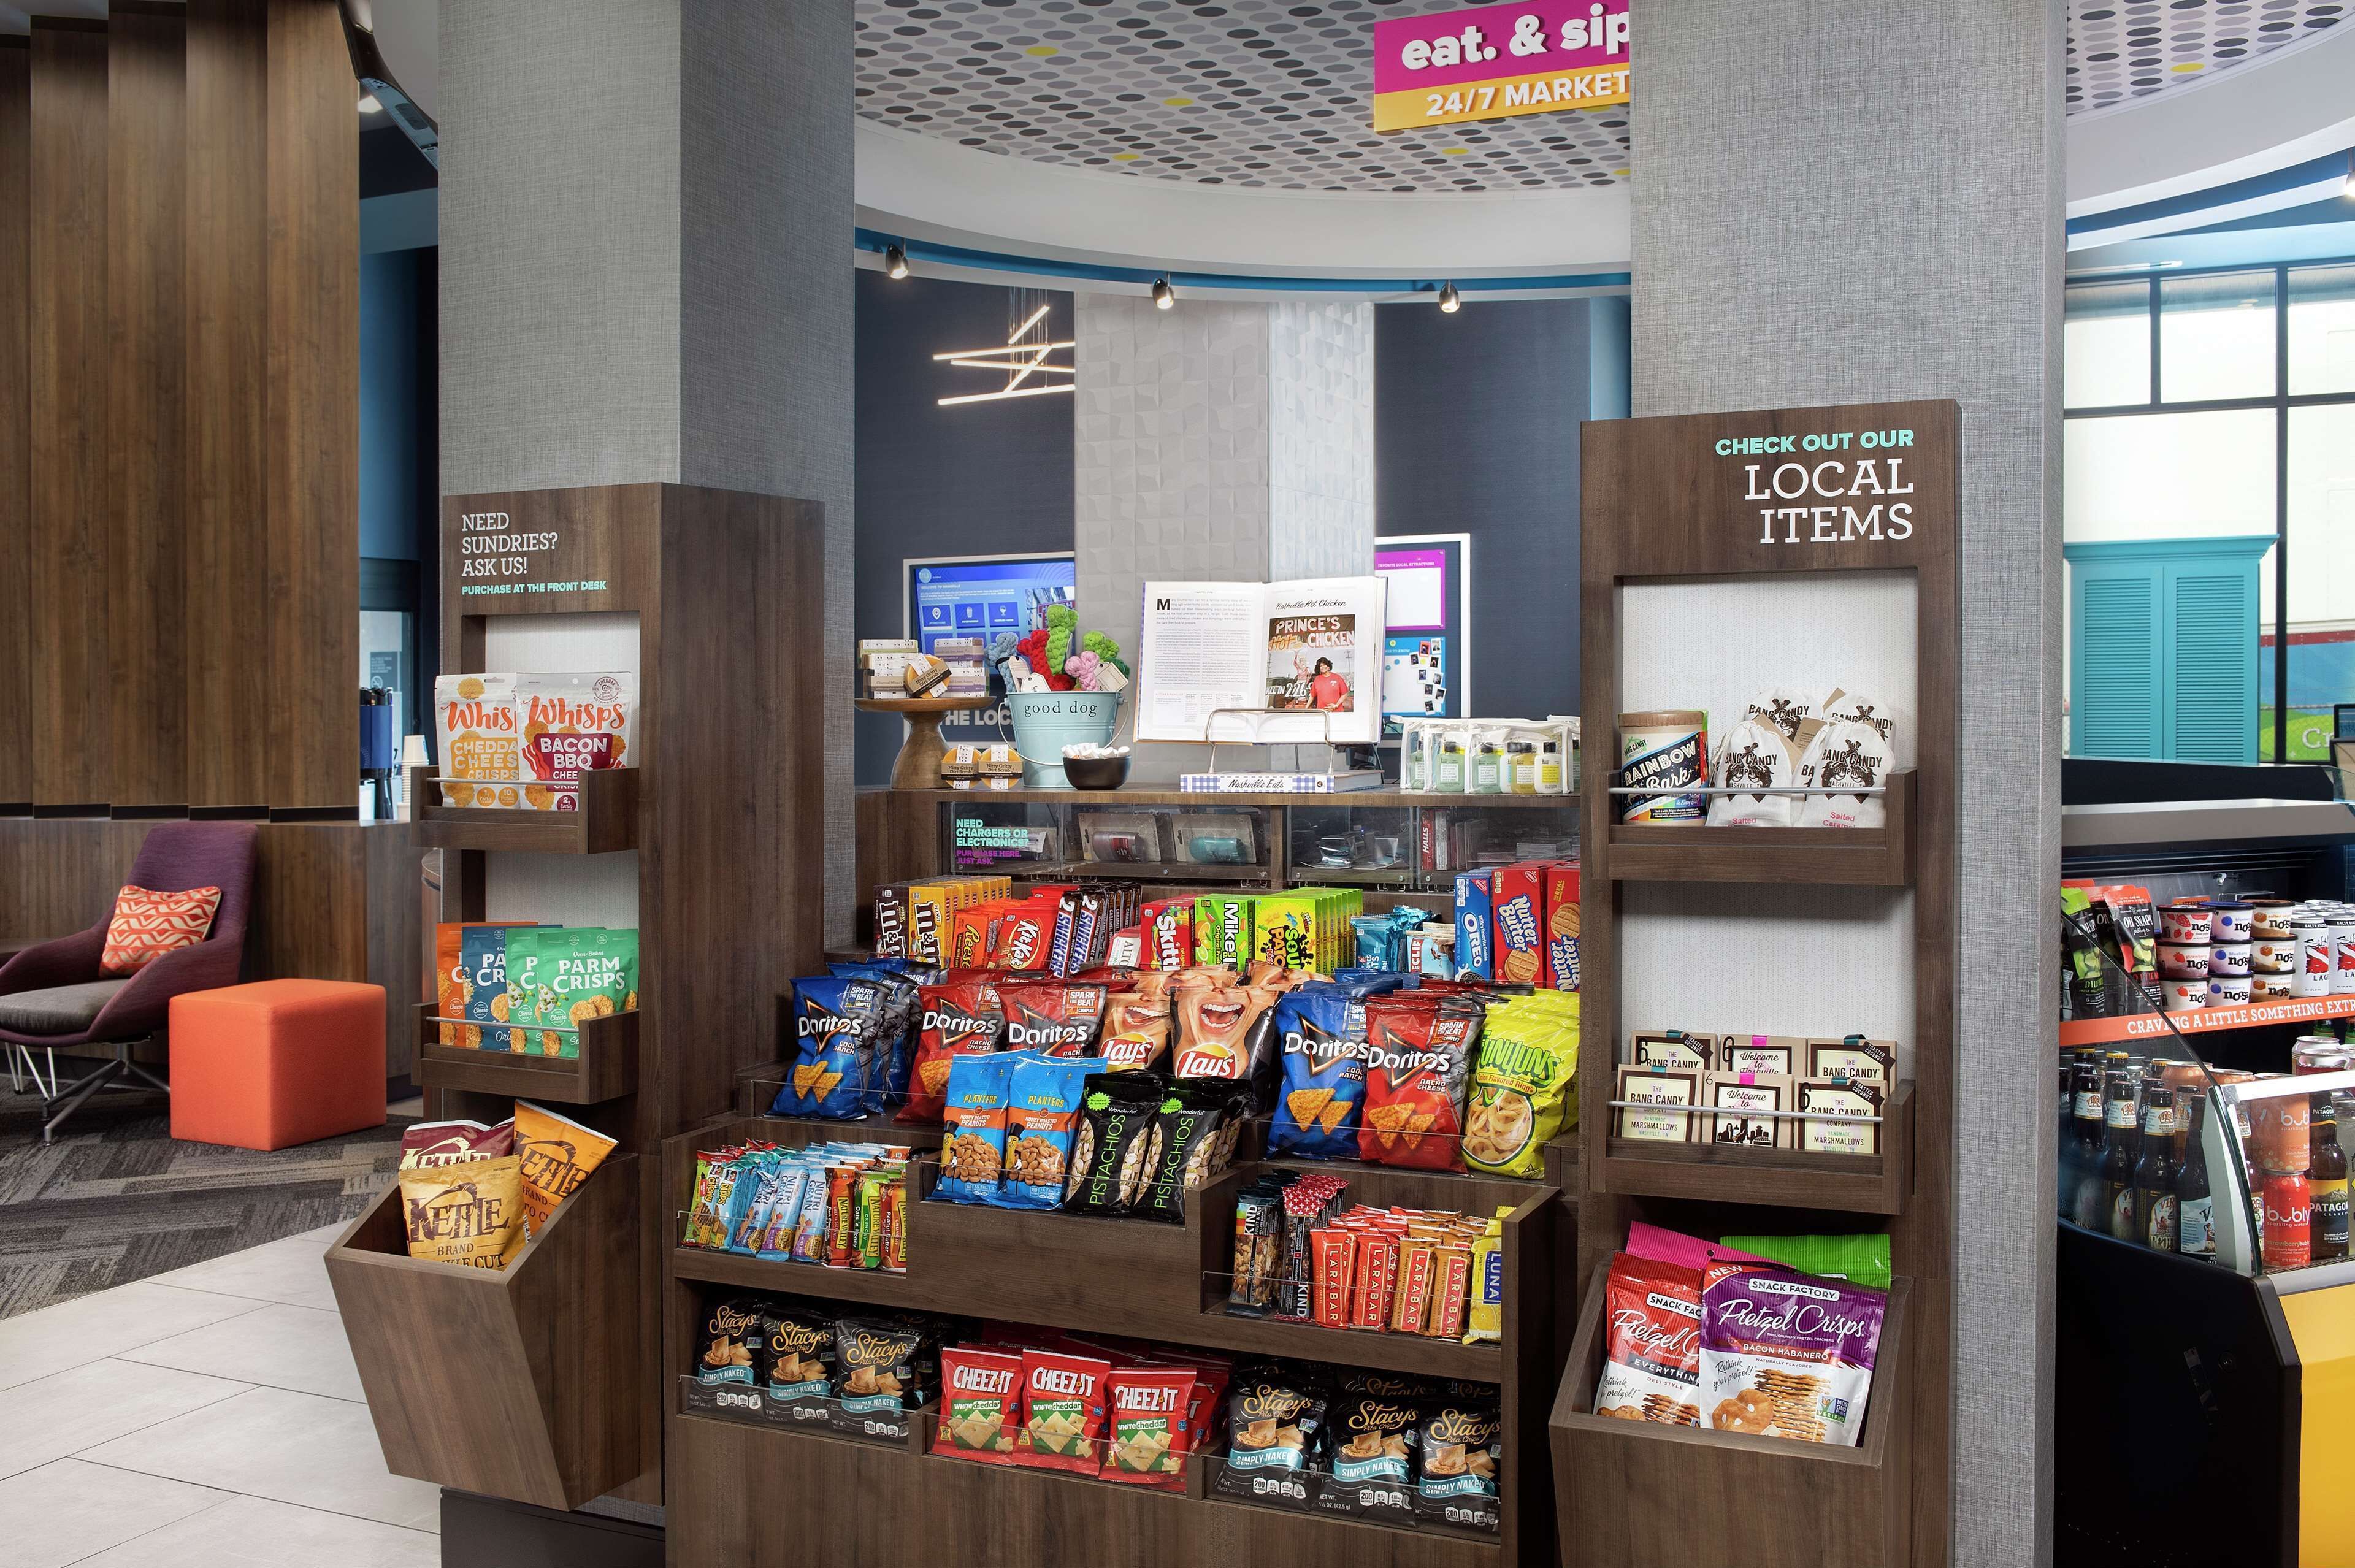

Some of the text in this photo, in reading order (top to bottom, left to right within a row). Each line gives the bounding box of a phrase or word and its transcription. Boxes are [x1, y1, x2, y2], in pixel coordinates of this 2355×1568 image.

[1401, 3, 1629, 70] eat. & sip
[1426, 70, 1629, 117] 24/7 MARKET
[1715, 430, 1914, 455] CHECK OUT OUR
[1745, 458, 1913, 500] LOCAL
[462, 513, 509, 532] NEED
[1760, 503, 1913, 543] ITEMS
[462, 532, 558, 554] SUNDRIES?
[461, 557, 527, 576] ASK US!
[462, 581, 606, 595] PURCHASE AT THE FRONT DESK
[1276, 617, 1340, 634] PRINCE'S
[1308, 631, 1354, 647] CHICKEN
[523, 695, 626, 731] Whisps
[1025, 700, 1097, 717] good dog
[540, 738, 607, 752] BACON
[554, 754, 593, 770] BBQ
[1625, 741, 1696, 786] RAINBOW
[1725, 752, 1777, 765] BANG CANDY
[1821, 749, 1882, 767] BANG CANDY
[1228, 778, 1284, 790] Nashville Eats
[1645, 767, 1690, 798] Bark
[1830, 812, 1855, 822] Salted
[956, 828, 1011, 837] CHARGERS
[957, 838, 1029, 846] ELECTRONICS?
[1224, 903, 1240, 950] Mike
[1499, 904, 1527, 952] Butter
[1512, 895, 1537, 945] Nutter
[2124, 915, 2153, 928] OH SNAP!
[1050, 912, 1072, 978] SNICKERS
[1070, 910, 1095, 974] SNICKERS
[1463, 912, 1482, 968] OREO
[1412, 940, 1420, 965] CLIF
[559, 957, 620, 974] PARM
[553, 972, 625, 993] CRISPS
[798, 1015, 863, 1036] Doritos
[923, 1011, 997, 1034] Doritos
[1438, 1020, 1465, 1029] SPARK
[2127, 1015, 2190, 1035] CRAVING
[2194, 1016, 2204, 1028] A
[2206, 1010, 2248, 1026] LITTLE
[2250, 1003, 2324, 1023] SOMETHING
[1009, 1023, 1088, 1044] Doritos
[1106, 1040, 1152, 1063] Lay's
[1285, 1033, 1369, 1060] Doritos
[1864, 1048, 1885, 1062] COCONUT
[1867, 1042, 1886, 1060] TOASTED
[1181, 1055, 1233, 1077] Lay's
[1368, 1047, 1451, 1071] Doritos
[1740, 1052, 1780, 1062] Welcome
[1754, 1061, 1763, 1069] to
[1339, 1073, 1363, 1081] RANCH
[1346, 1067, 1363, 1076] COOL
[1823, 1067, 1879, 1078] BANG CANDY
[1488, 1075, 1513, 1085] Flavored
[1515, 1082, 1534, 1093] Rings
[963, 1095, 997, 1104] PLANTERS
[1028, 1096, 1064, 1107] PLANTERS
[1630, 1094, 1684, 1105] BANG CANDY
[1727, 1090, 1767, 1101] Welcome
[1631, 1122, 1678, 1131] MARSHMALLOWS
[1813, 1136, 1864, 1145] MARSHMALLOWS
[1089, 1115, 1126, 1204] PISTACHIOS
[1155, 1117, 1194, 1208] PISTACHIOS
[776, 1176, 787, 1205] GRAIN
[783, 1176, 797, 1205] NUTRI
[805, 1180, 816, 1211] GRAIN
[812, 1181, 825, 1211] NUTRI
[837, 1199, 849, 1248] NATURE VALLEY
[1244, 1205, 1257, 1235] KIND
[437, 1243, 475, 1256] BRAND
[1709, 1265, 1744, 1279] NEW
[1752, 1280, 1837, 1299] SNACK FACTORY
[709, 1306, 756, 1336] Stacy's
[1718, 1299, 1864, 1343] Pretzel Crisps
[772, 1321, 829, 1353] Stacy's
[1614, 1309, 1682, 1355] Pretzel
[846, 1333, 906, 1366] Stacy's
[1744, 1343, 1829, 1361] BACON HABANERO
[1715, 1358, 1744, 1377] Rethink
[1712, 1366, 1755, 1392] your pretzel!
[973, 1401, 1001, 1410] cheddar
[1243, 1384, 1314, 1419] Stacy's
[1349, 1400, 1417, 1432] Stacy's
[1816, 1410, 1845, 1423] VERIFIED
[1461, 1435, 1480, 1444] Chips
[1342, 1461, 1400, 1477] SIMPLY NAKED
[1360, 1491, 1373, 1500] 200
[1426, 1480, 1484, 1494] SIMPLY NAKED
